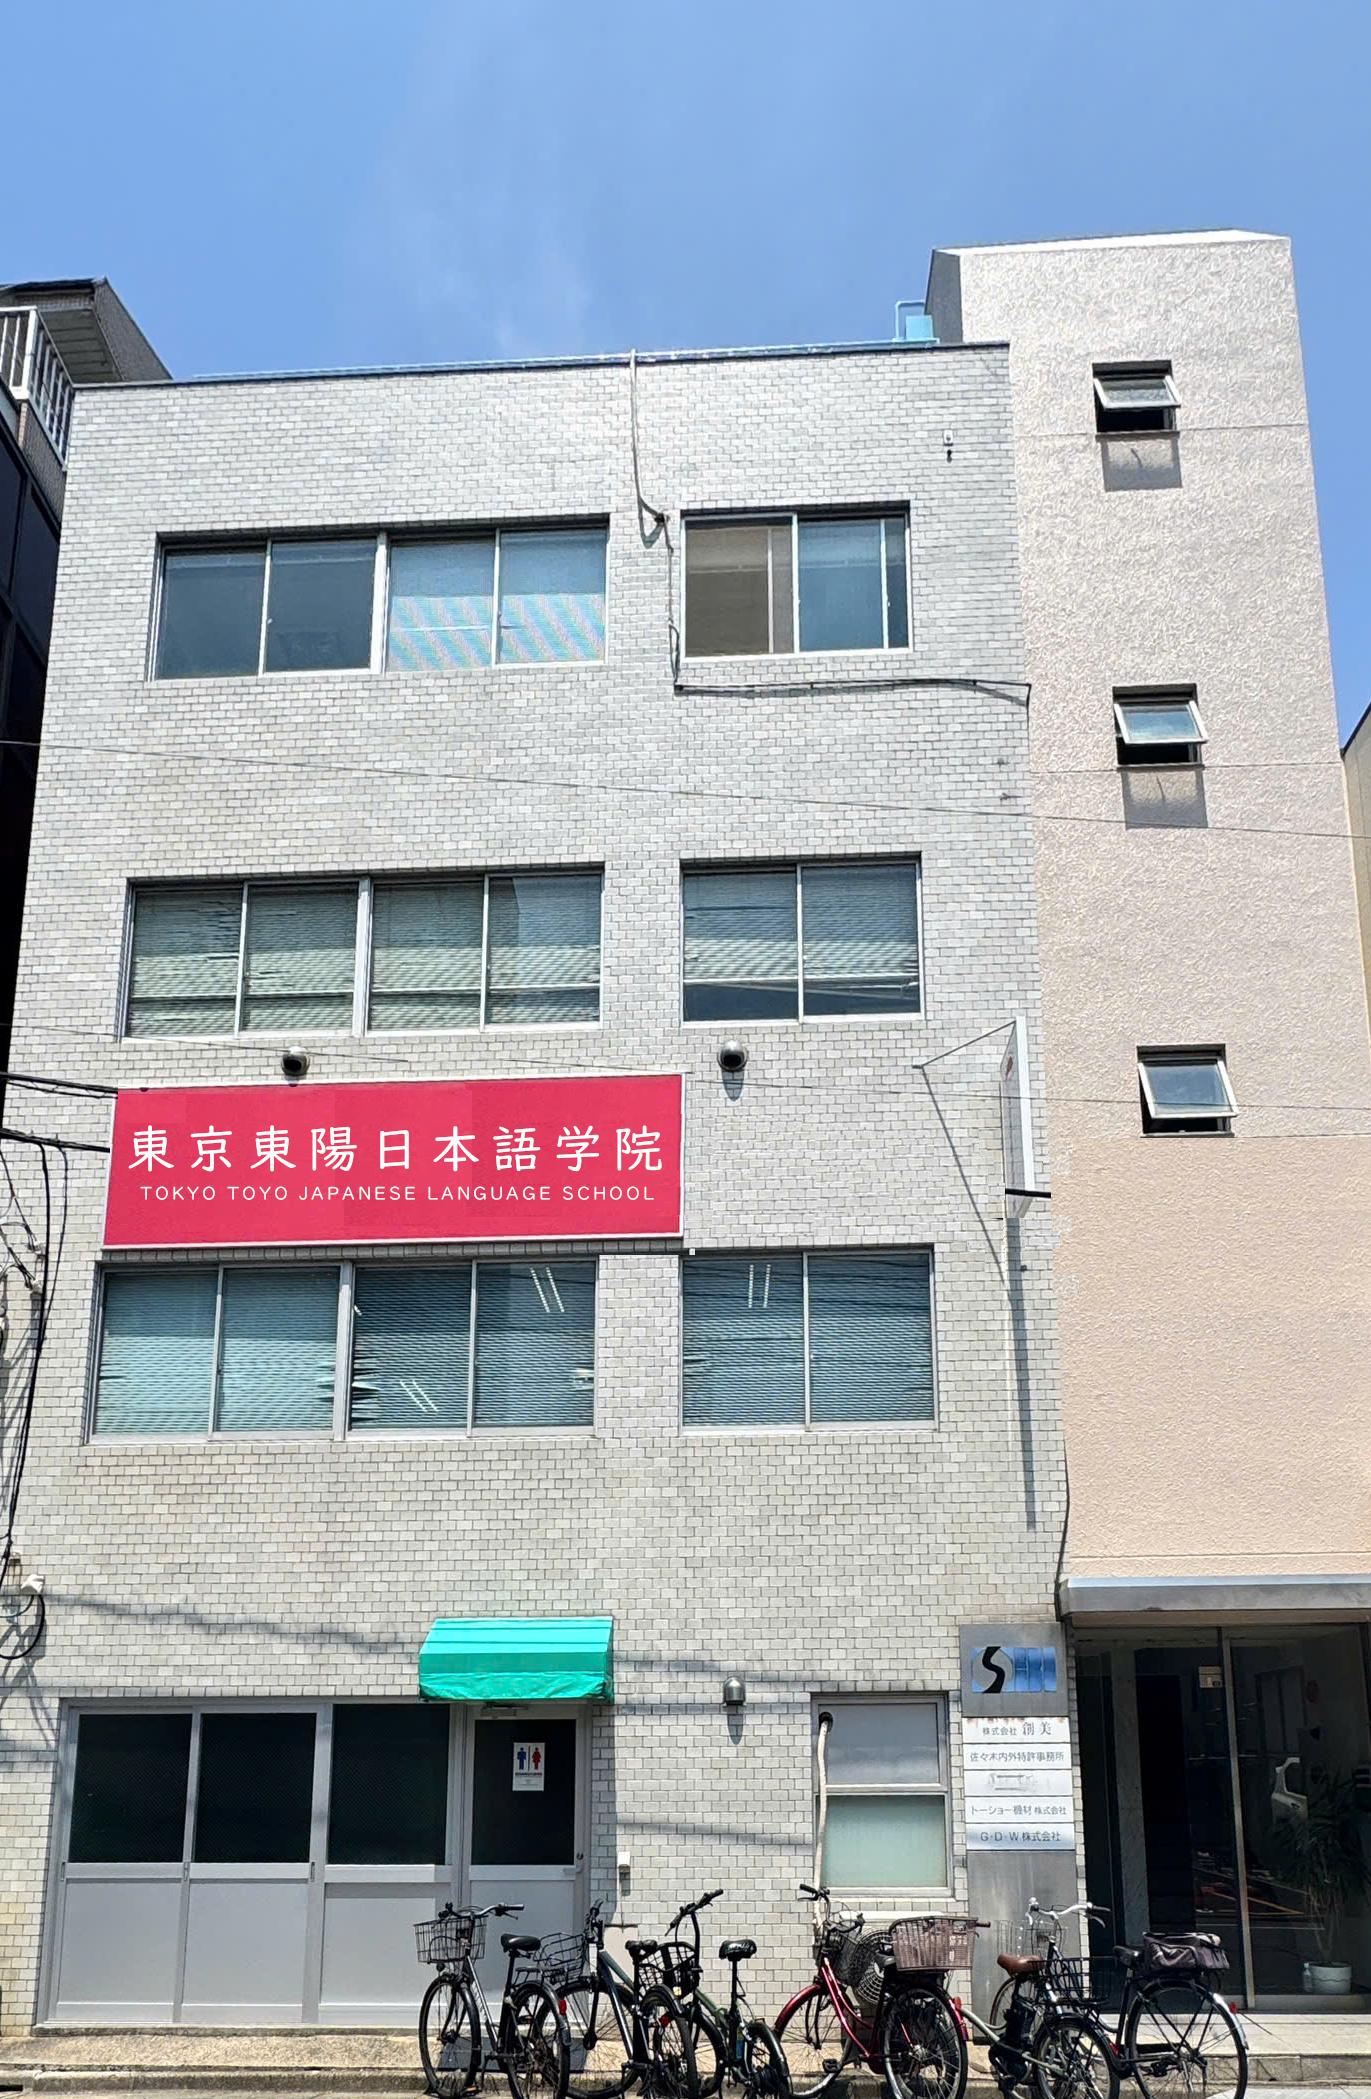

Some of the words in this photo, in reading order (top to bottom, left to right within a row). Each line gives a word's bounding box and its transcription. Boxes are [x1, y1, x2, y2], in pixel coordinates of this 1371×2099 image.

[128, 1125, 663, 1173] 東京東陽日本語学院
[139, 1185, 216, 1201] TOKYO
[227, 1185, 288, 1201] TOYO
[298, 1185, 416, 1201] JAPANESE
[427, 1185, 551, 1201] LANGUAGE
[562, 1185, 655, 1201] SCHOOL
[982, 1726, 1017, 1736] 株式会社
[970, 1751, 1064, 1762] 佐々木内外特許事務所
